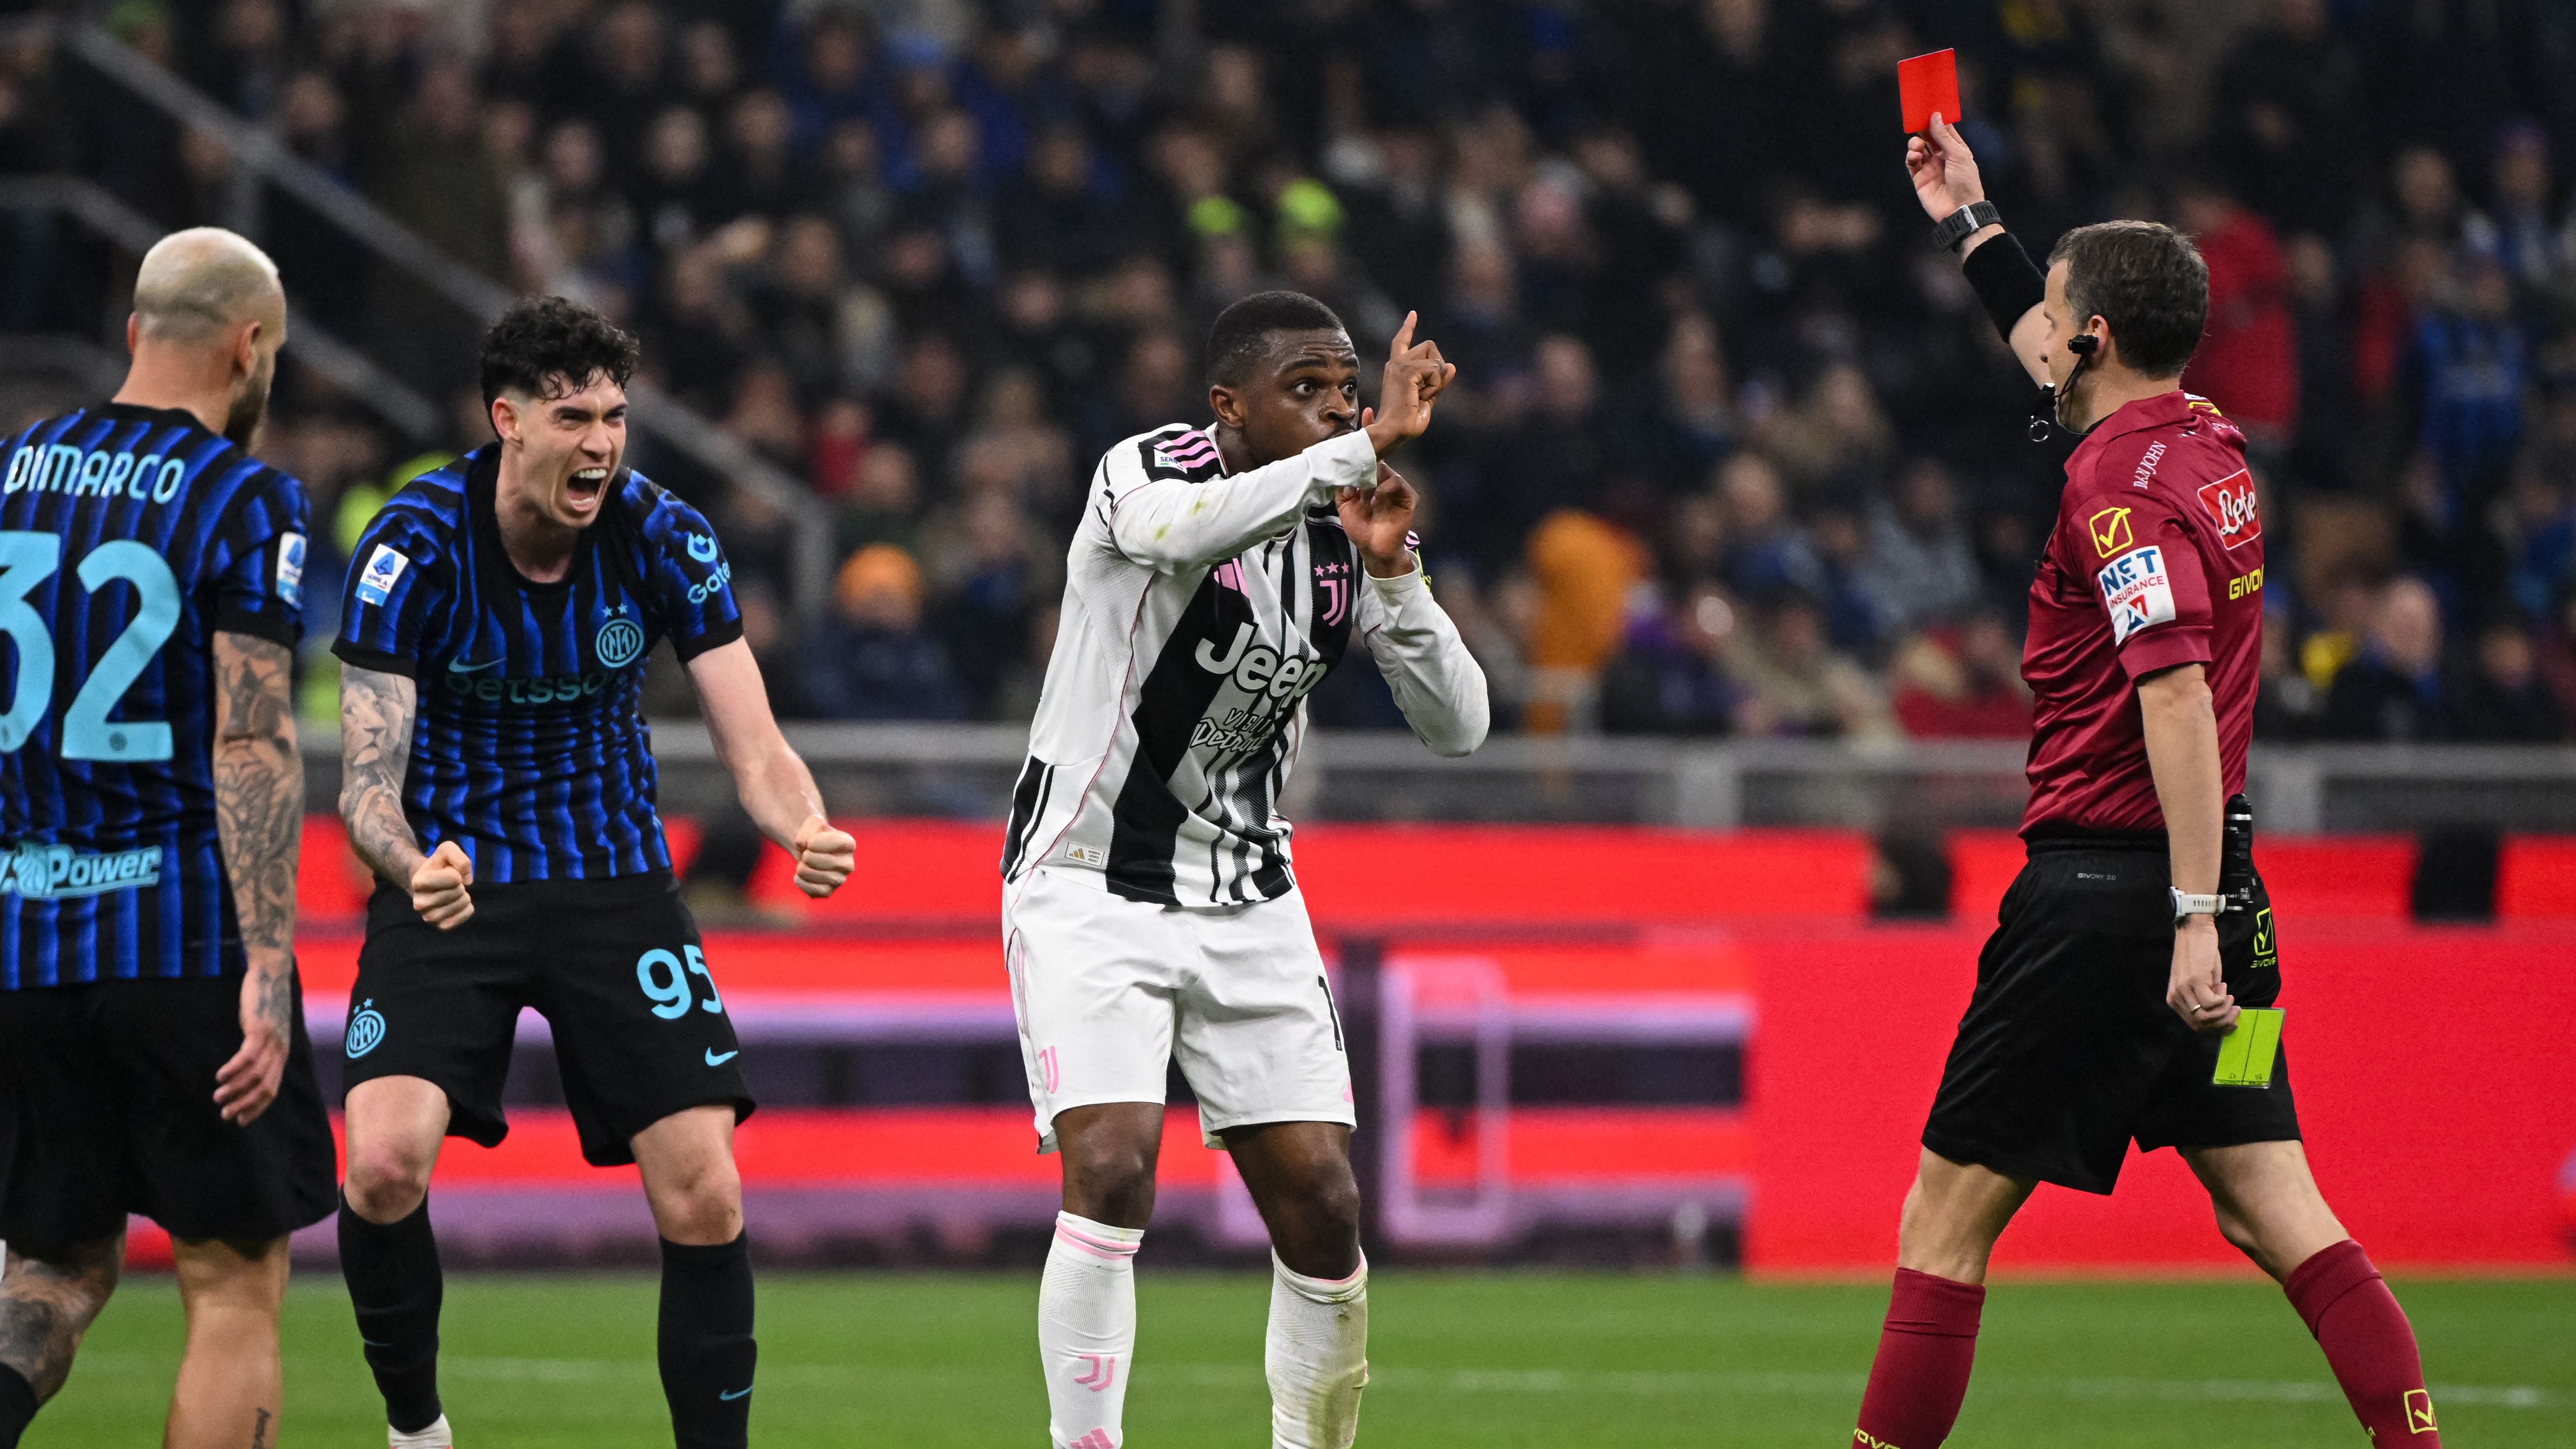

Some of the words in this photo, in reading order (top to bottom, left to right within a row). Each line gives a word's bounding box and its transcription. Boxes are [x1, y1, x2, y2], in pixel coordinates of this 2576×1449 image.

[4, 443, 185, 504] DIMARCO
[2101, 549, 2157, 597] NET
[2109, 576, 2165, 609] INSURANCE
[444, 670, 615, 704] betsso
[1195, 622, 1328, 709] Jeep
[1223, 707, 1272, 734] VISIT
[45, 848, 160, 896] Power
[636, 945, 723, 1020] 95
